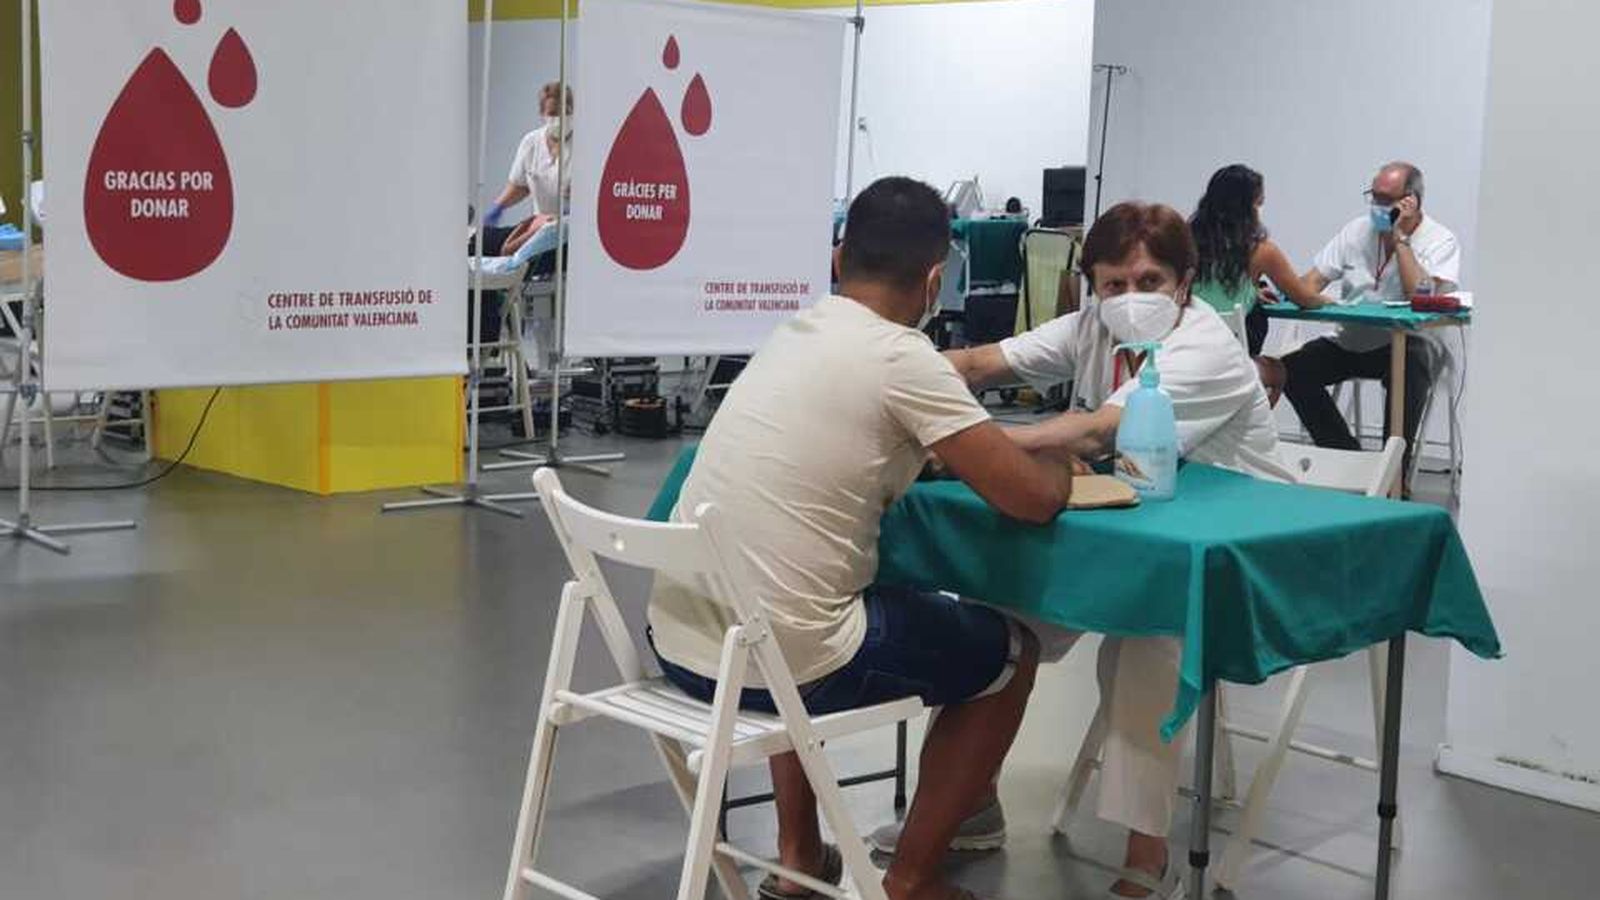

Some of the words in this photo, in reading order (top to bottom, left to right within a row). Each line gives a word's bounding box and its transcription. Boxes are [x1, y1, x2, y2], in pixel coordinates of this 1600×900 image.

[104, 170, 176, 190] GRACIAS
[180, 170, 213, 190] POR
[658, 183, 677, 199] PER
[131, 198, 189, 217] DONAR
[626, 204, 662, 220] DONAR
[704, 282, 734, 294] CENTRE
[737, 282, 747, 294] DE
[800, 282, 809, 294] DE
[268, 293, 315, 308] CENTRE
[319, 292, 334, 306] DE
[339, 287, 414, 305] TRANSFUSIÓ
[418, 290, 432, 303] DE
[704, 300, 713, 311] LA
[716, 300, 755, 311] COMUNITAT
[759, 299, 800, 311] VALENCIANA
[268, 316, 282, 330] LA
[286, 313, 349, 329] COMUNITAT
[354, 311, 419, 327] VALENCIANA
